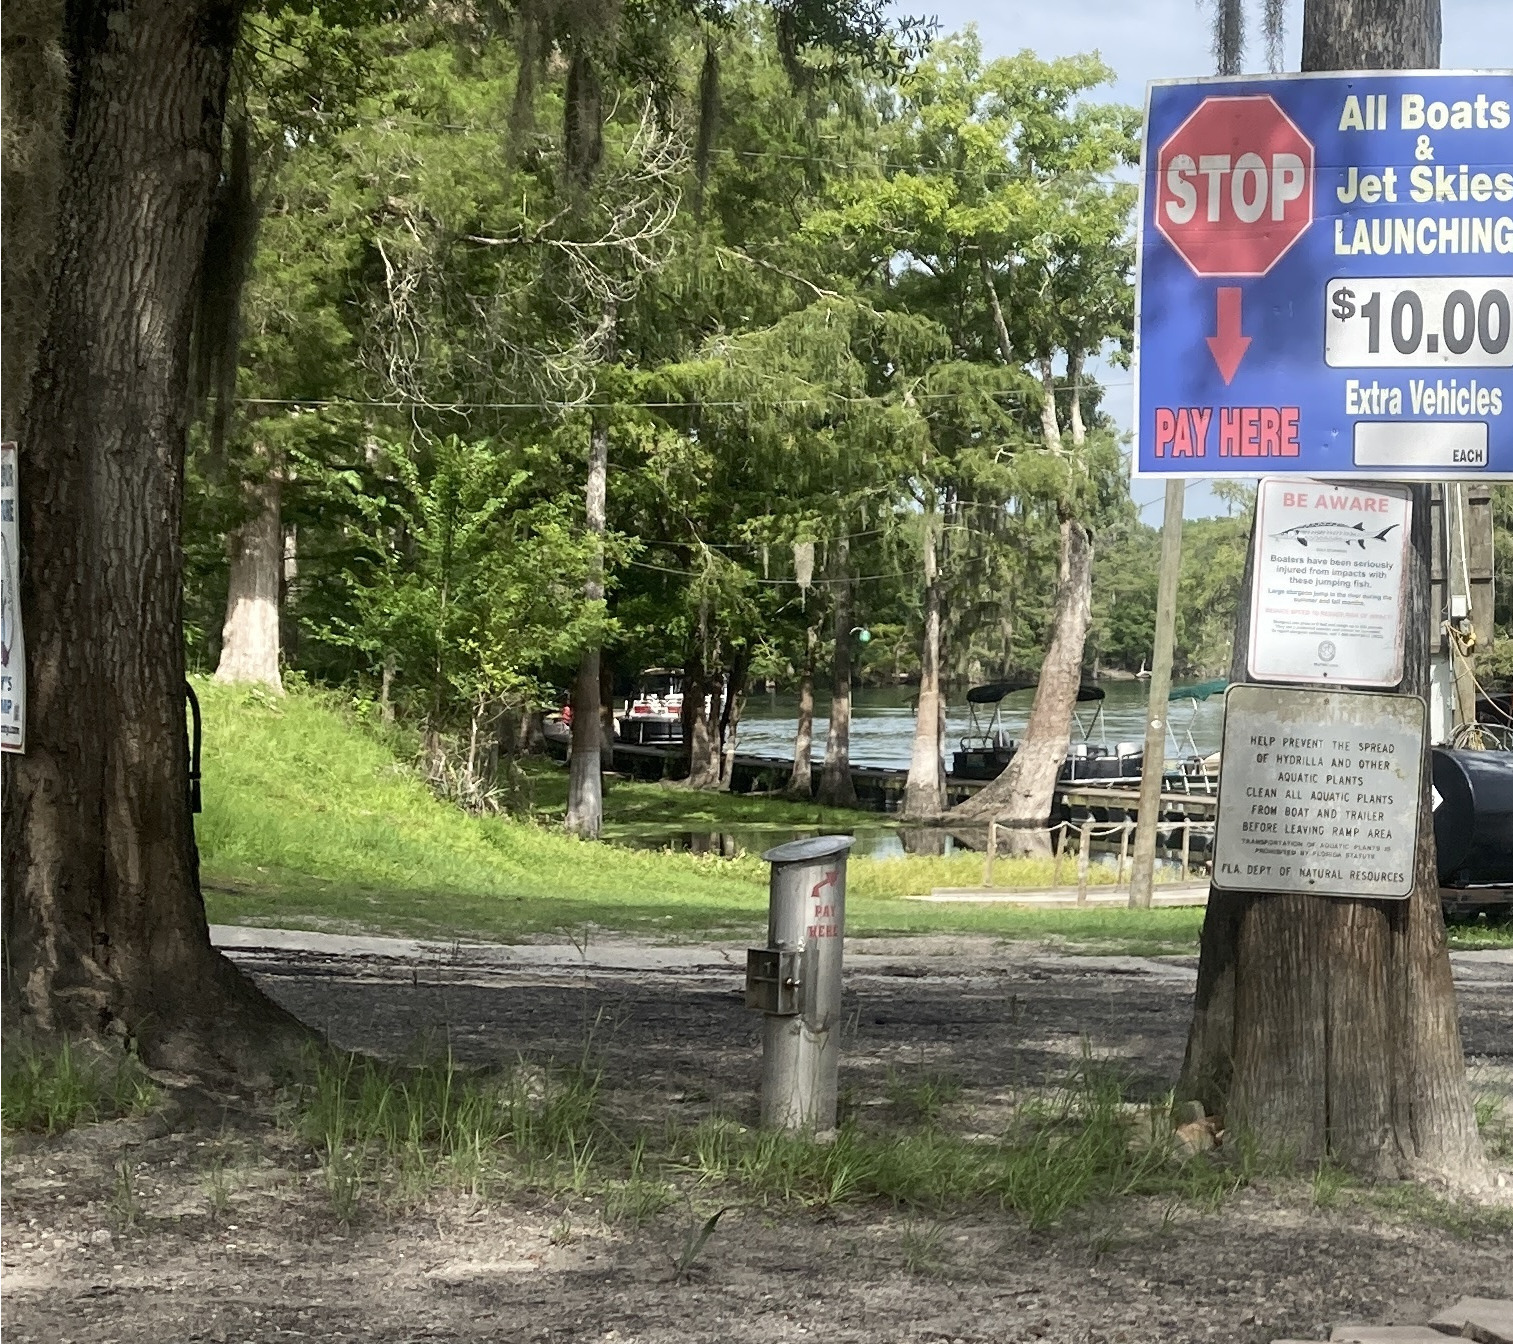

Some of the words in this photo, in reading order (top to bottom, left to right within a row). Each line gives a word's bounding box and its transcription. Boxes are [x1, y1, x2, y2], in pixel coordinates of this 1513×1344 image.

[1338, 94, 1387, 131] All
[1401, 94, 1510, 130] Boats
[1414, 135, 1435, 161] &
[1165, 152, 1305, 225] STOP
[1336, 166, 1398, 204] Jet
[1331, 286, 1511, 355] $10.00
[1345, 380, 1402, 416] Extra
[1409, 379, 1502, 416] Vehicles
[1154, 407, 1212, 457] PAY
[1219, 406, 1300, 457] HERE
[1452, 449, 1483, 463] EACH
[1283, 492, 1308, 507] BE
[1314, 494, 1389, 513] AWARE
[1270, 554, 1304, 564] Boaters
[1307, 556, 1327, 565] have
[1330, 558, 1351, 566] been
[1354, 559, 1394, 570] seriously
[1276, 566, 1306, 574] injured
[1310, 567, 1330, 576] from
[1332, 568, 1366, 578] impacts
[1369, 571, 1387, 579] with
[1290, 576, 1314, 584] these
[1315, 578, 1350, 588] jumping
[1354, 579, 1372, 588] fish.
[1251, 736, 1276, 748] HELP
[1282, 738, 1324, 749] PREVENT
[1332, 740, 1350, 750] THE
[1358, 743, 1394, 754] SPREAD
[1256, 753, 1269, 763] OF
[1276, 755, 1324, 766] HYDRILLA
[1331, 758, 1351, 768] AND
[1358, 759, 1390, 770] OTHER
[1278, 772, 1318, 784] AQUATIC
[1326, 775, 1363, 786] PLANTS
[1246, 787, 1277, 798] CLEAN
[1285, 789, 1302, 799] ALL
[1310, 791, 1350, 802] AQUATIC
[1357, 794, 1393, 804] PLANTS
[1251, 805, 1277, 816] FROM
[1285, 806, 1309, 818] BOAT
[1317, 808, 1337, 818] AND
[1346, 810, 1384, 822] TRAILER
[1242, 822, 1278, 833] BEFORE
[1285, 823, 1324, 835] LEAVING
[1332, 826, 1359, 838] RAMP
[1367, 828, 1392, 839] AREA
[1320, 842, 1349, 850] AQUATIC
[1280, 866, 1291, 876] OF
[1300, 868, 1343, 880] NATURAL
[1350, 871, 1404, 882] RESOURCES
[815, 905, 836, 917] PAY
[807, 925, 838, 937] HERE
